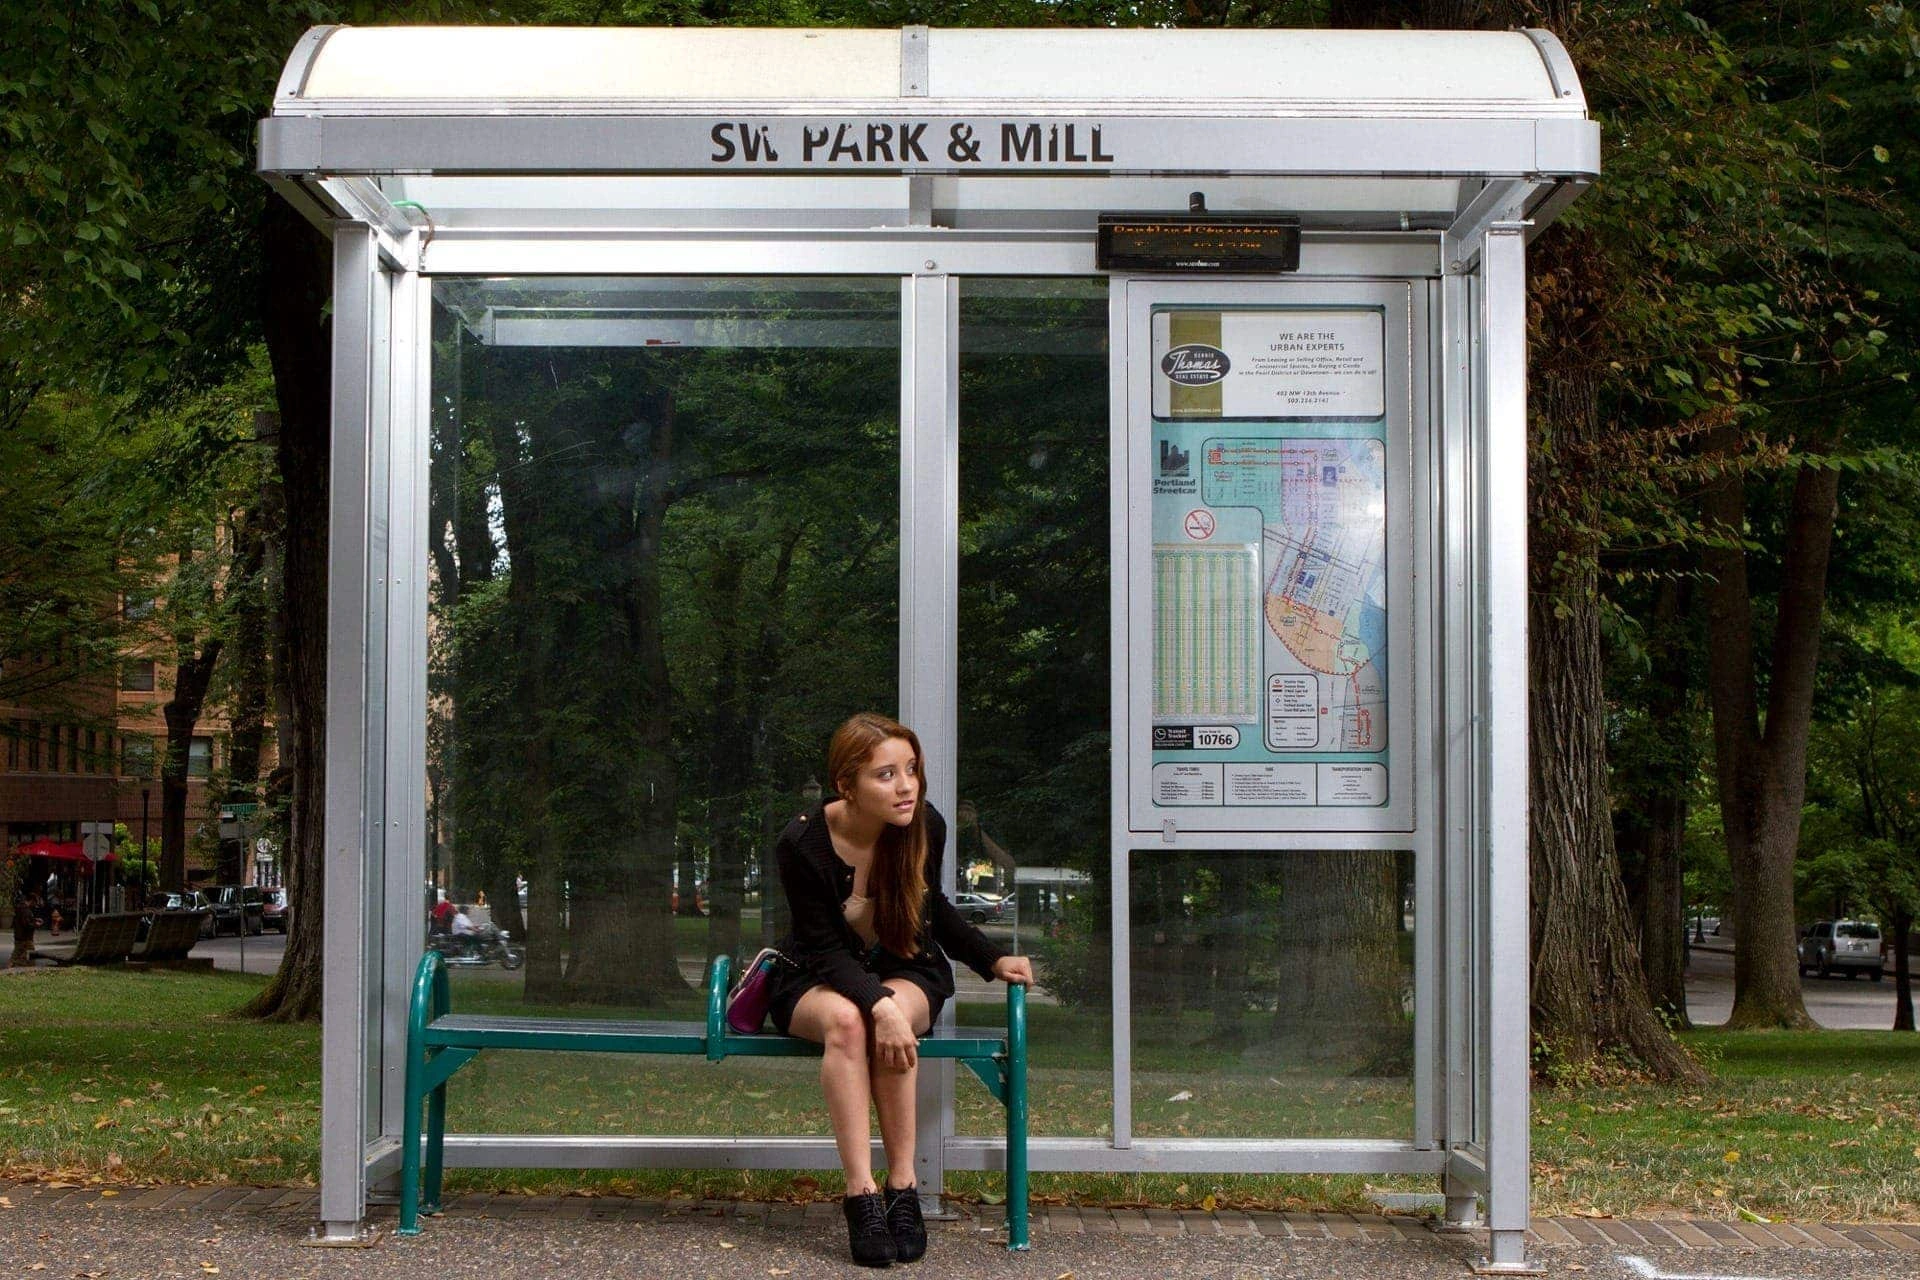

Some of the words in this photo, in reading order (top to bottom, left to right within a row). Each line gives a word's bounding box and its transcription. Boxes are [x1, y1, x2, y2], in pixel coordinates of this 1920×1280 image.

[803, 123, 929, 162] PARK
[947, 123, 981, 162] &
[1001, 123, 1114, 162] MILL
[1279, 332, 1294, 340] WE
[1297, 332, 1315, 340] ARE
[1317, 332, 1335, 340] THE
[1270, 343, 1303, 351] URBAN
[1306, 343, 1345, 351] EXPERTS
[1168, 350, 1221, 374] Thomas
[1154, 479, 1196, 487] Portland
[1198, 734, 1233, 745] 10766
